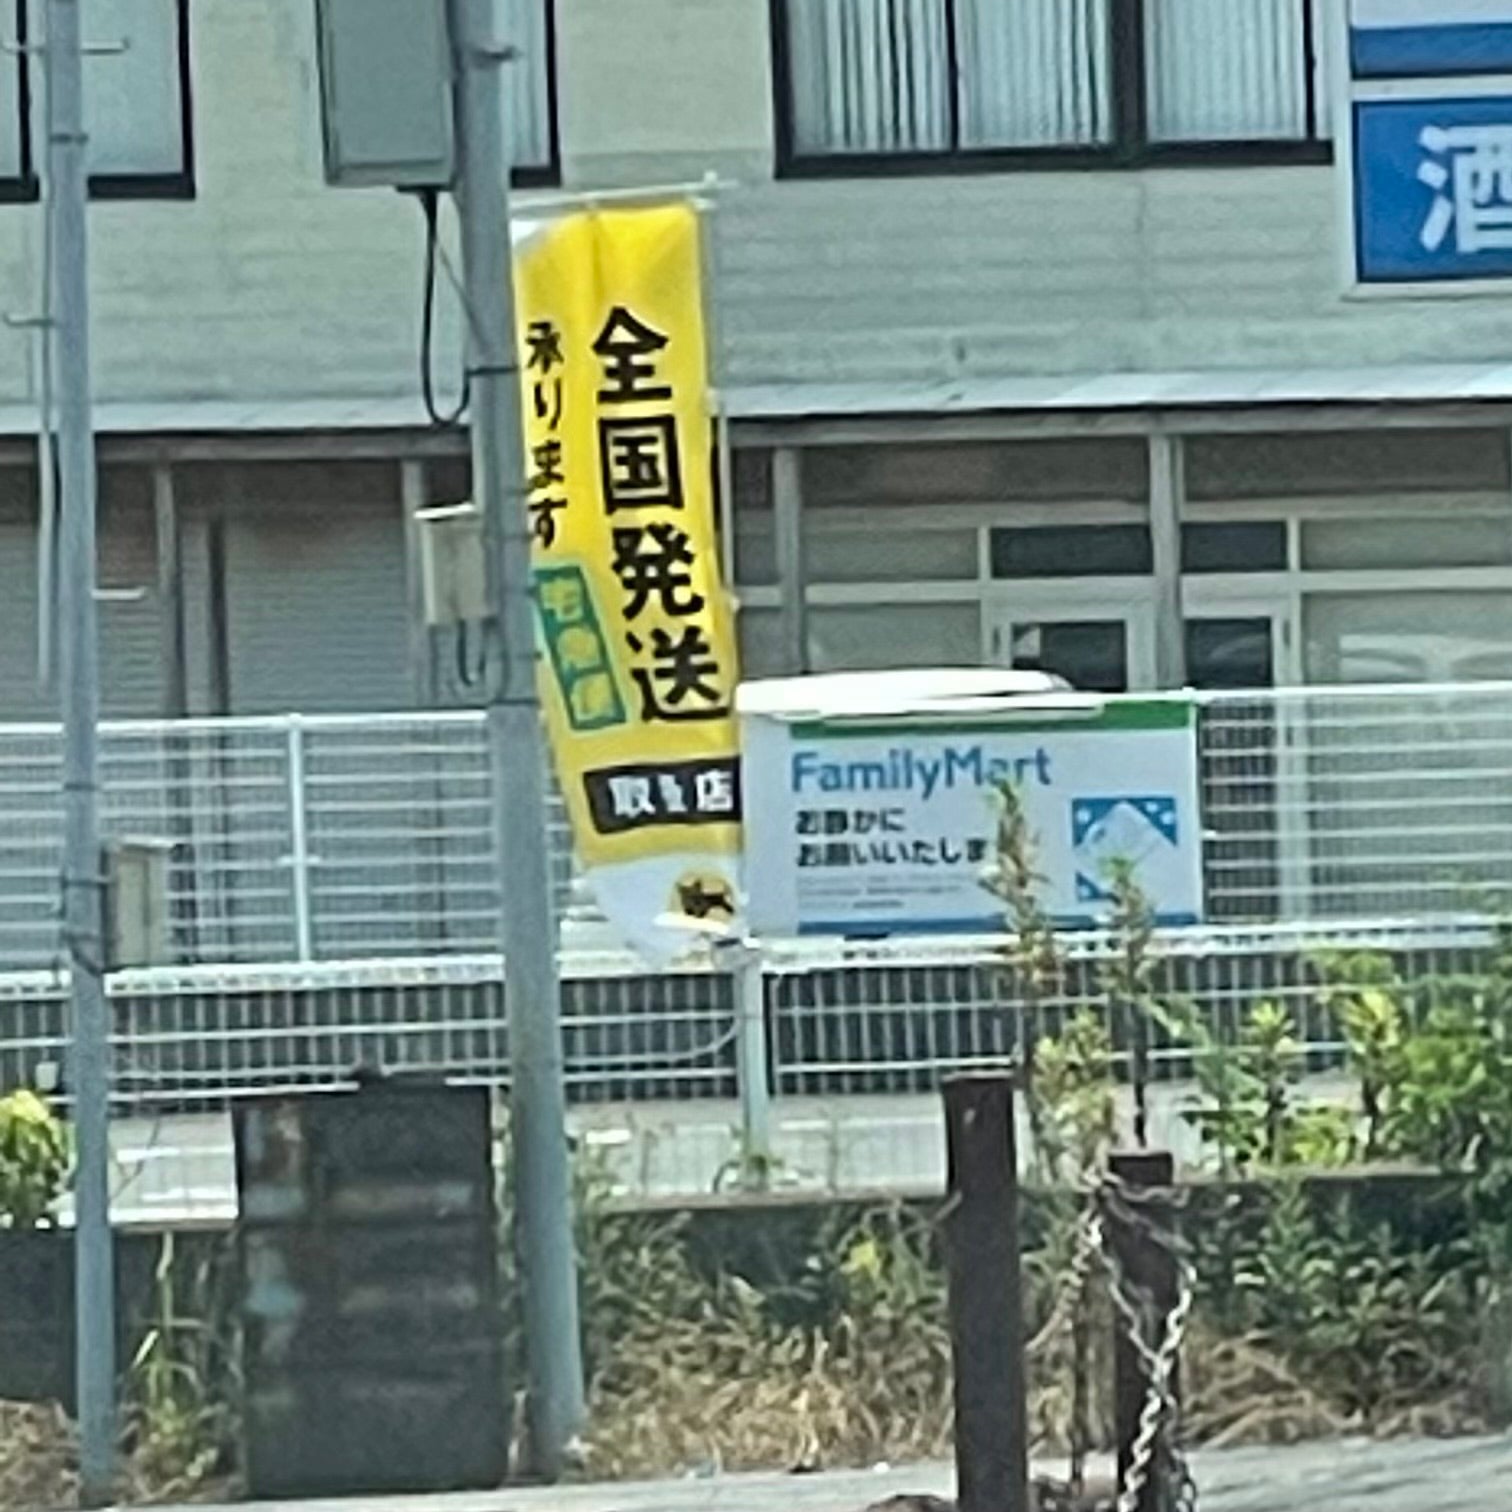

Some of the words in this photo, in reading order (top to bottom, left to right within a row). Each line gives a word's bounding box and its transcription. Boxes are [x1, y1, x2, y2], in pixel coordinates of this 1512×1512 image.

[592, 306, 729, 722] 全国発送
[791, 745, 1053, 801] FamilyMart
